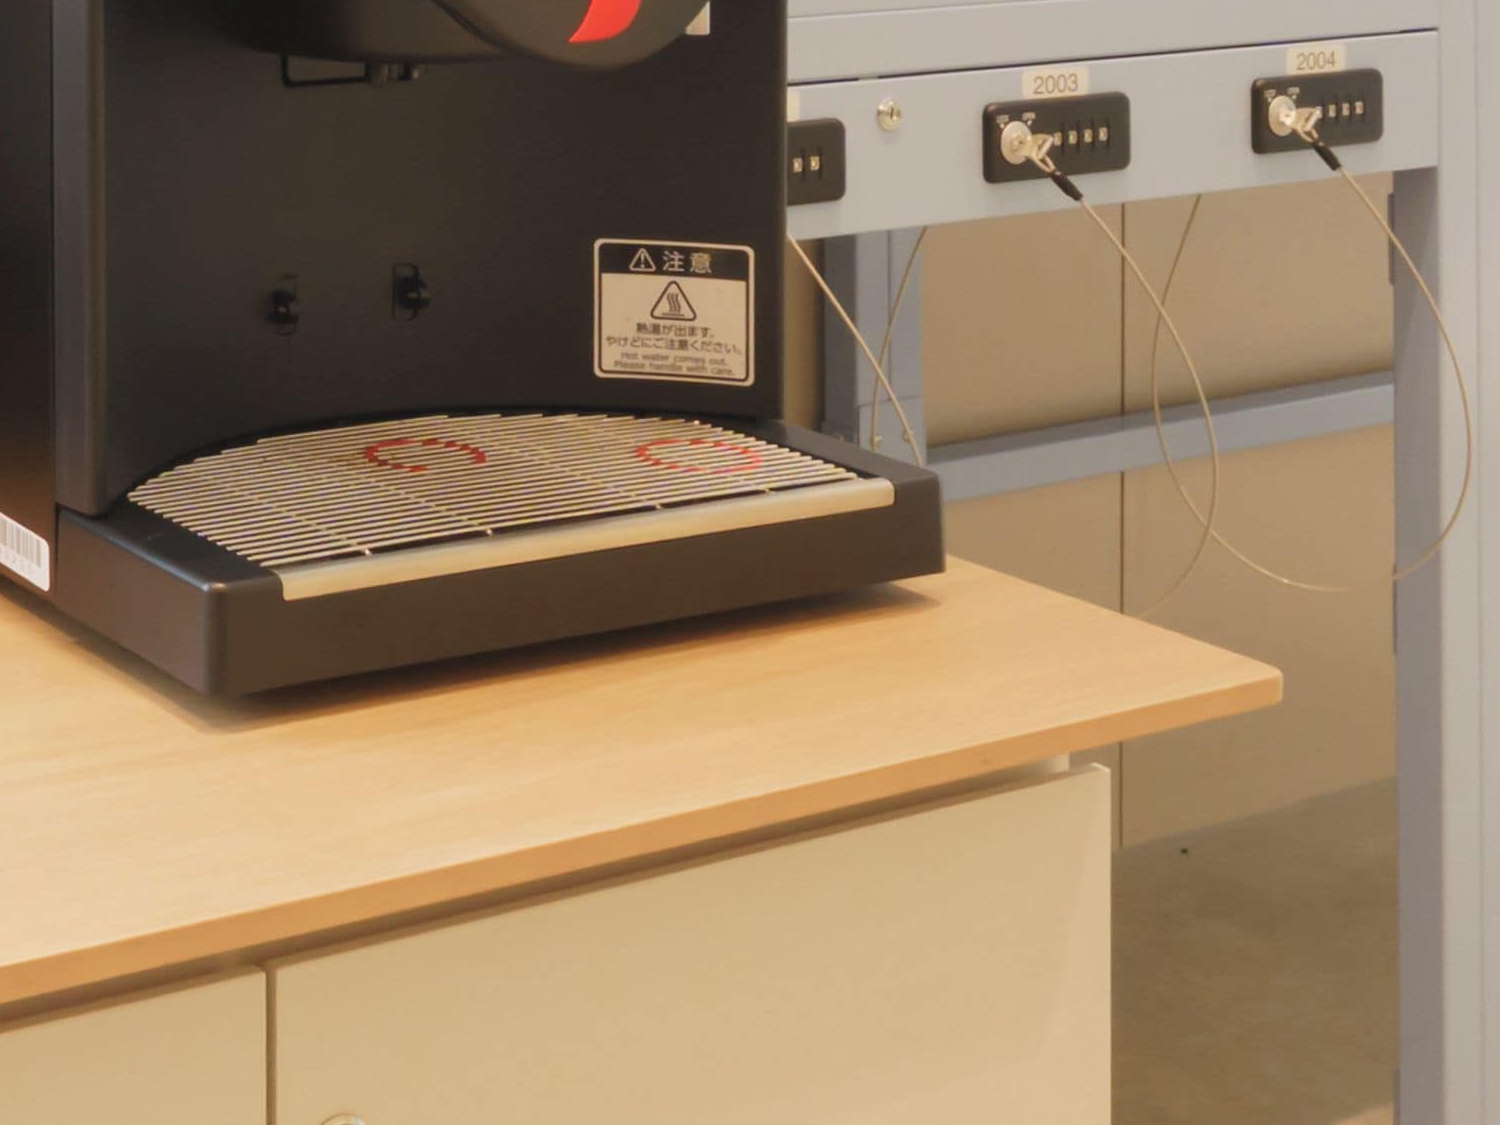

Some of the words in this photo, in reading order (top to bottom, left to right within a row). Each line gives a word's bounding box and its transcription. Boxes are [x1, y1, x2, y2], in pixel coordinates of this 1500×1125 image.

[1296, 50, 1336, 71] 2004
[1033, 73, 1078, 95] 2003
[662, 250, 712, 274] 注意
